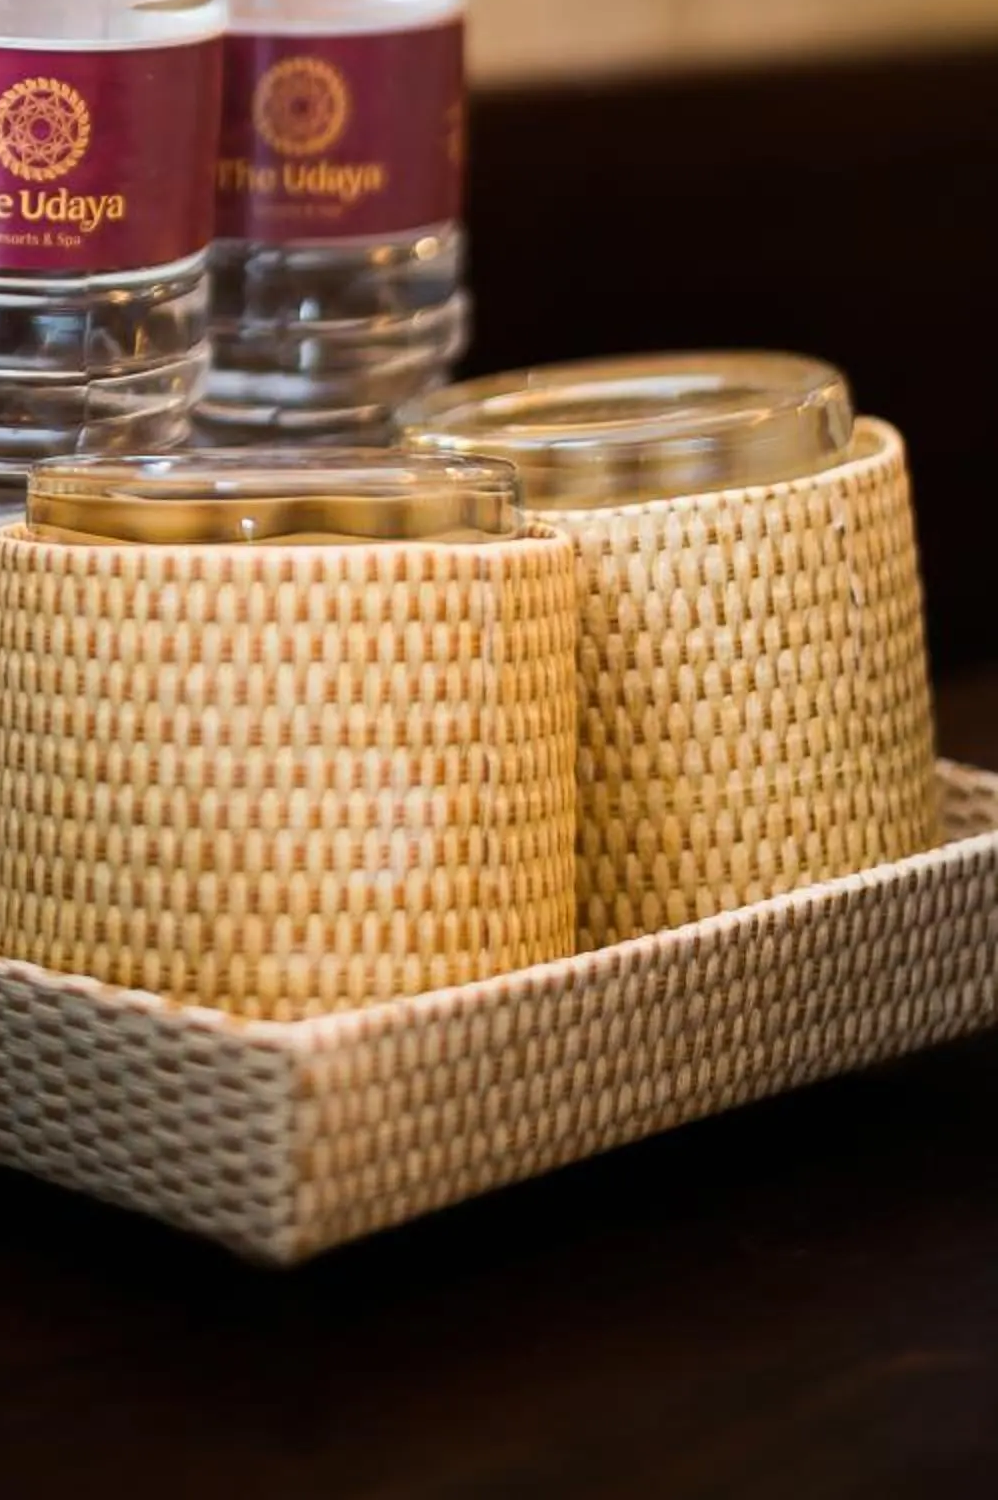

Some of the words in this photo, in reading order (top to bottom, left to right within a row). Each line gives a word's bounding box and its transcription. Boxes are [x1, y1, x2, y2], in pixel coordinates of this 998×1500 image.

[283, 163, 384, 204] Udaya
[18, 187, 126, 233] Udaya
[42, 231, 53, 246] &
[57, 232, 81, 249] Spa
